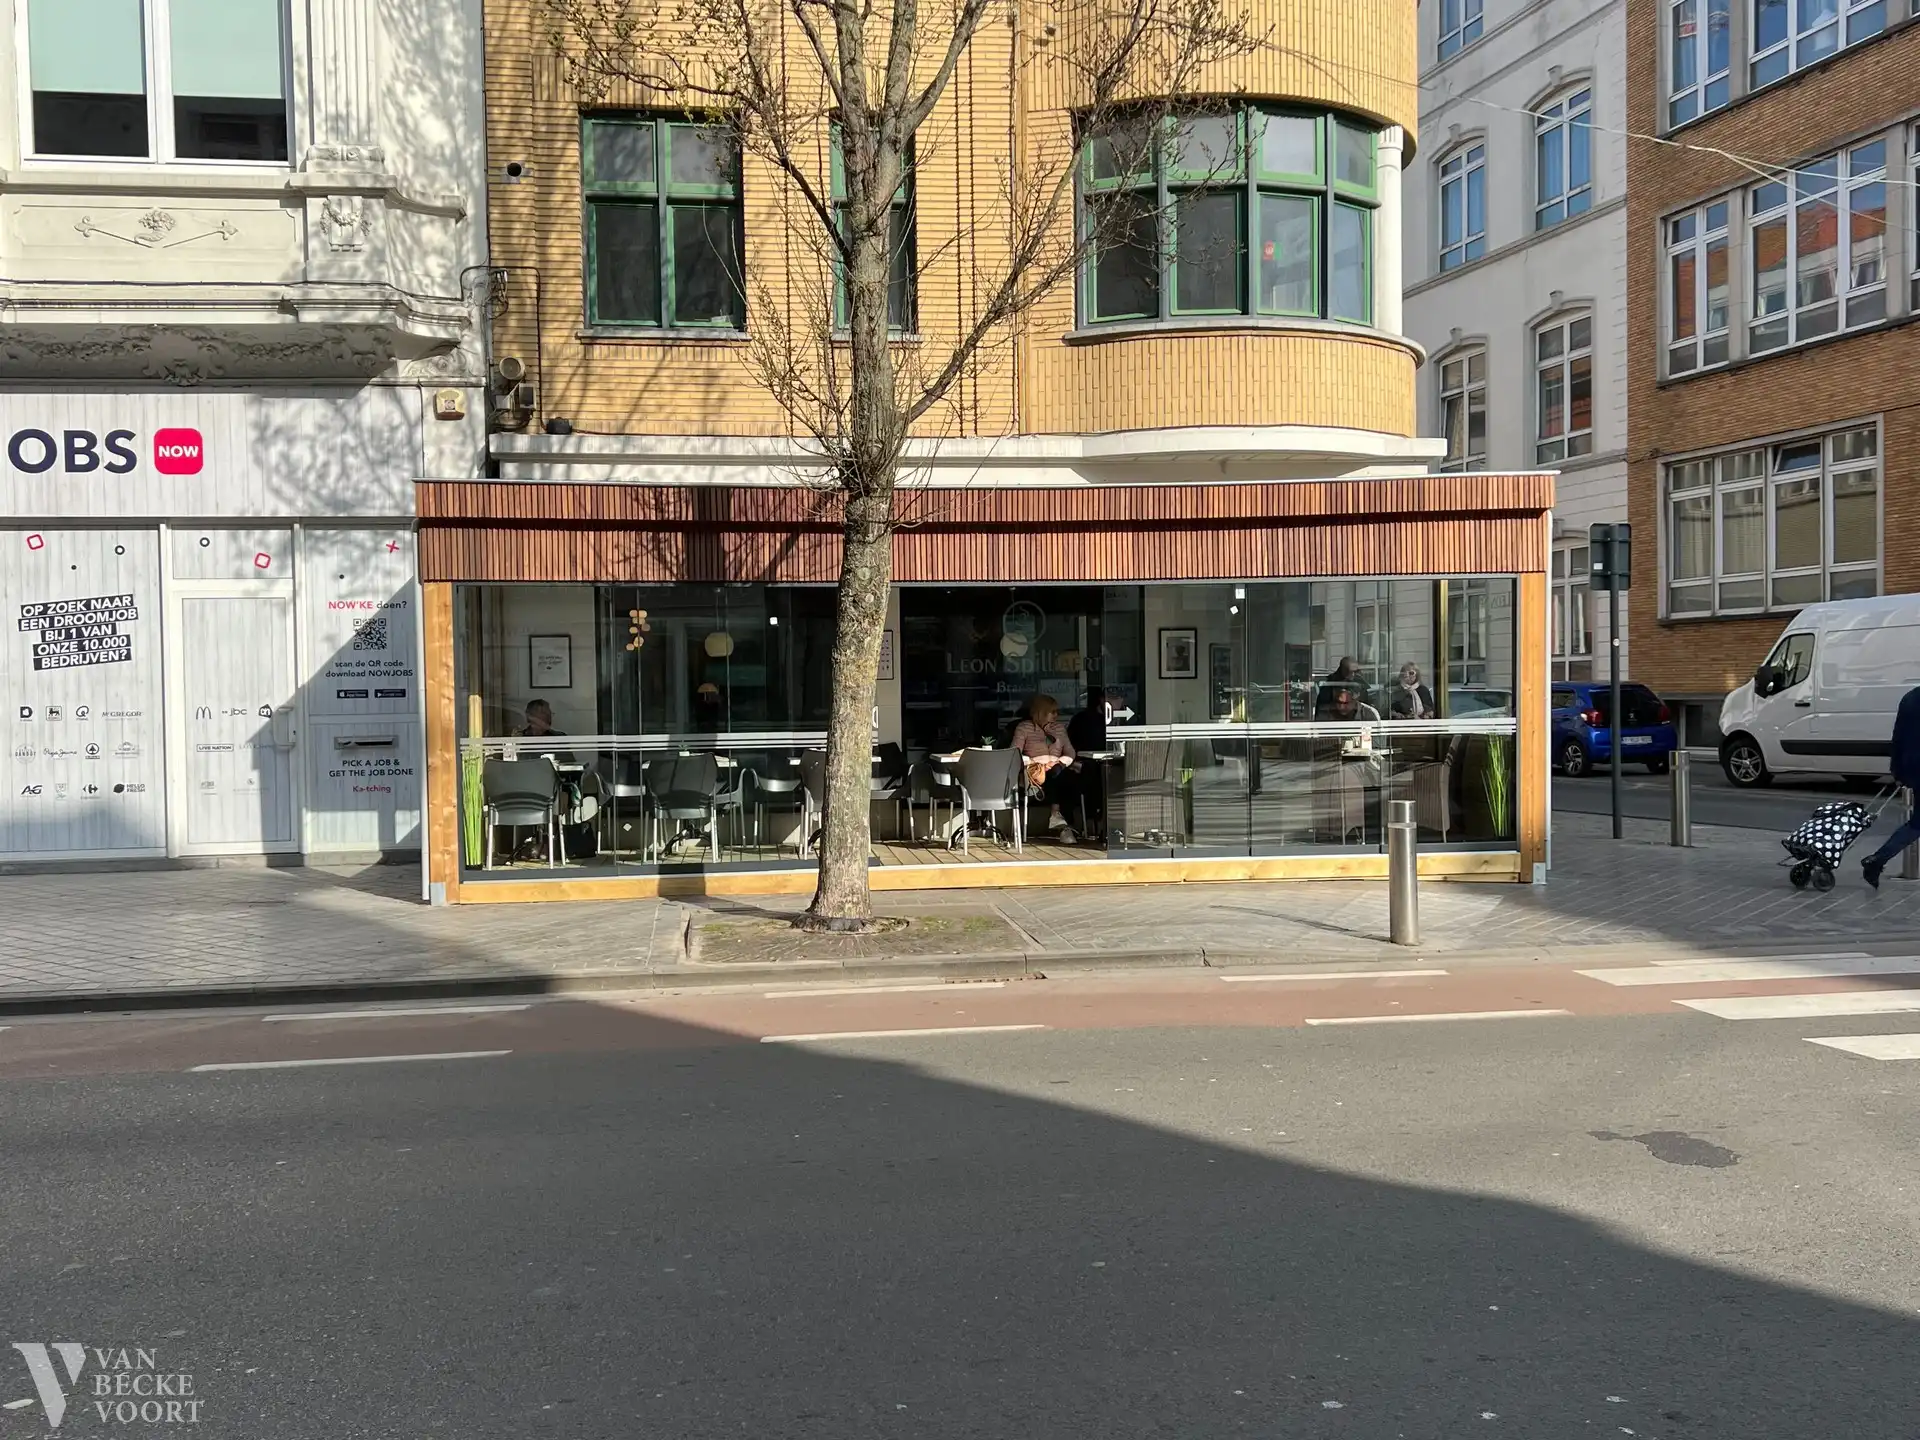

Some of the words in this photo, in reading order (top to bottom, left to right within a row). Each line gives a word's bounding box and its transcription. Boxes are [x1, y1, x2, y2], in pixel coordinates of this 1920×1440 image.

[8, 429, 137, 474] OBS
[158, 445, 199, 458] NOW
[23, 605, 44, 617] OP
[47, 600, 87, 615] ZOEK
[90, 596, 132, 610] NAAR
[328, 601, 373, 610] NOW'KE
[376, 601, 407, 609] doen?
[20, 617, 50, 631] EEN
[54, 609, 137, 627] DROOMJOB
[45, 629, 66, 642] BIJ
[69, 628, 77, 639] 1
[81, 624, 112, 637] VAN
[37, 641, 78, 655] ONZE
[82, 636, 128, 651] 10.000
[41, 649, 128, 669] BEDRIJVEN?
[355, 660, 366, 668] de
[367, 660, 381, 668] QR
[325, 669, 366, 678] download
[368, 669, 414, 677] NOWJOBS
[229, 707, 247, 717] jbc
[342, 759, 363, 767] PICK
[364, 759, 372, 767] A
[374, 759, 391, 767] JOB
[328, 770, 346, 778] GET
[348, 769, 366, 777] THE
[367, 769, 385, 777] JOB
[387, 768, 414, 776] DONE
